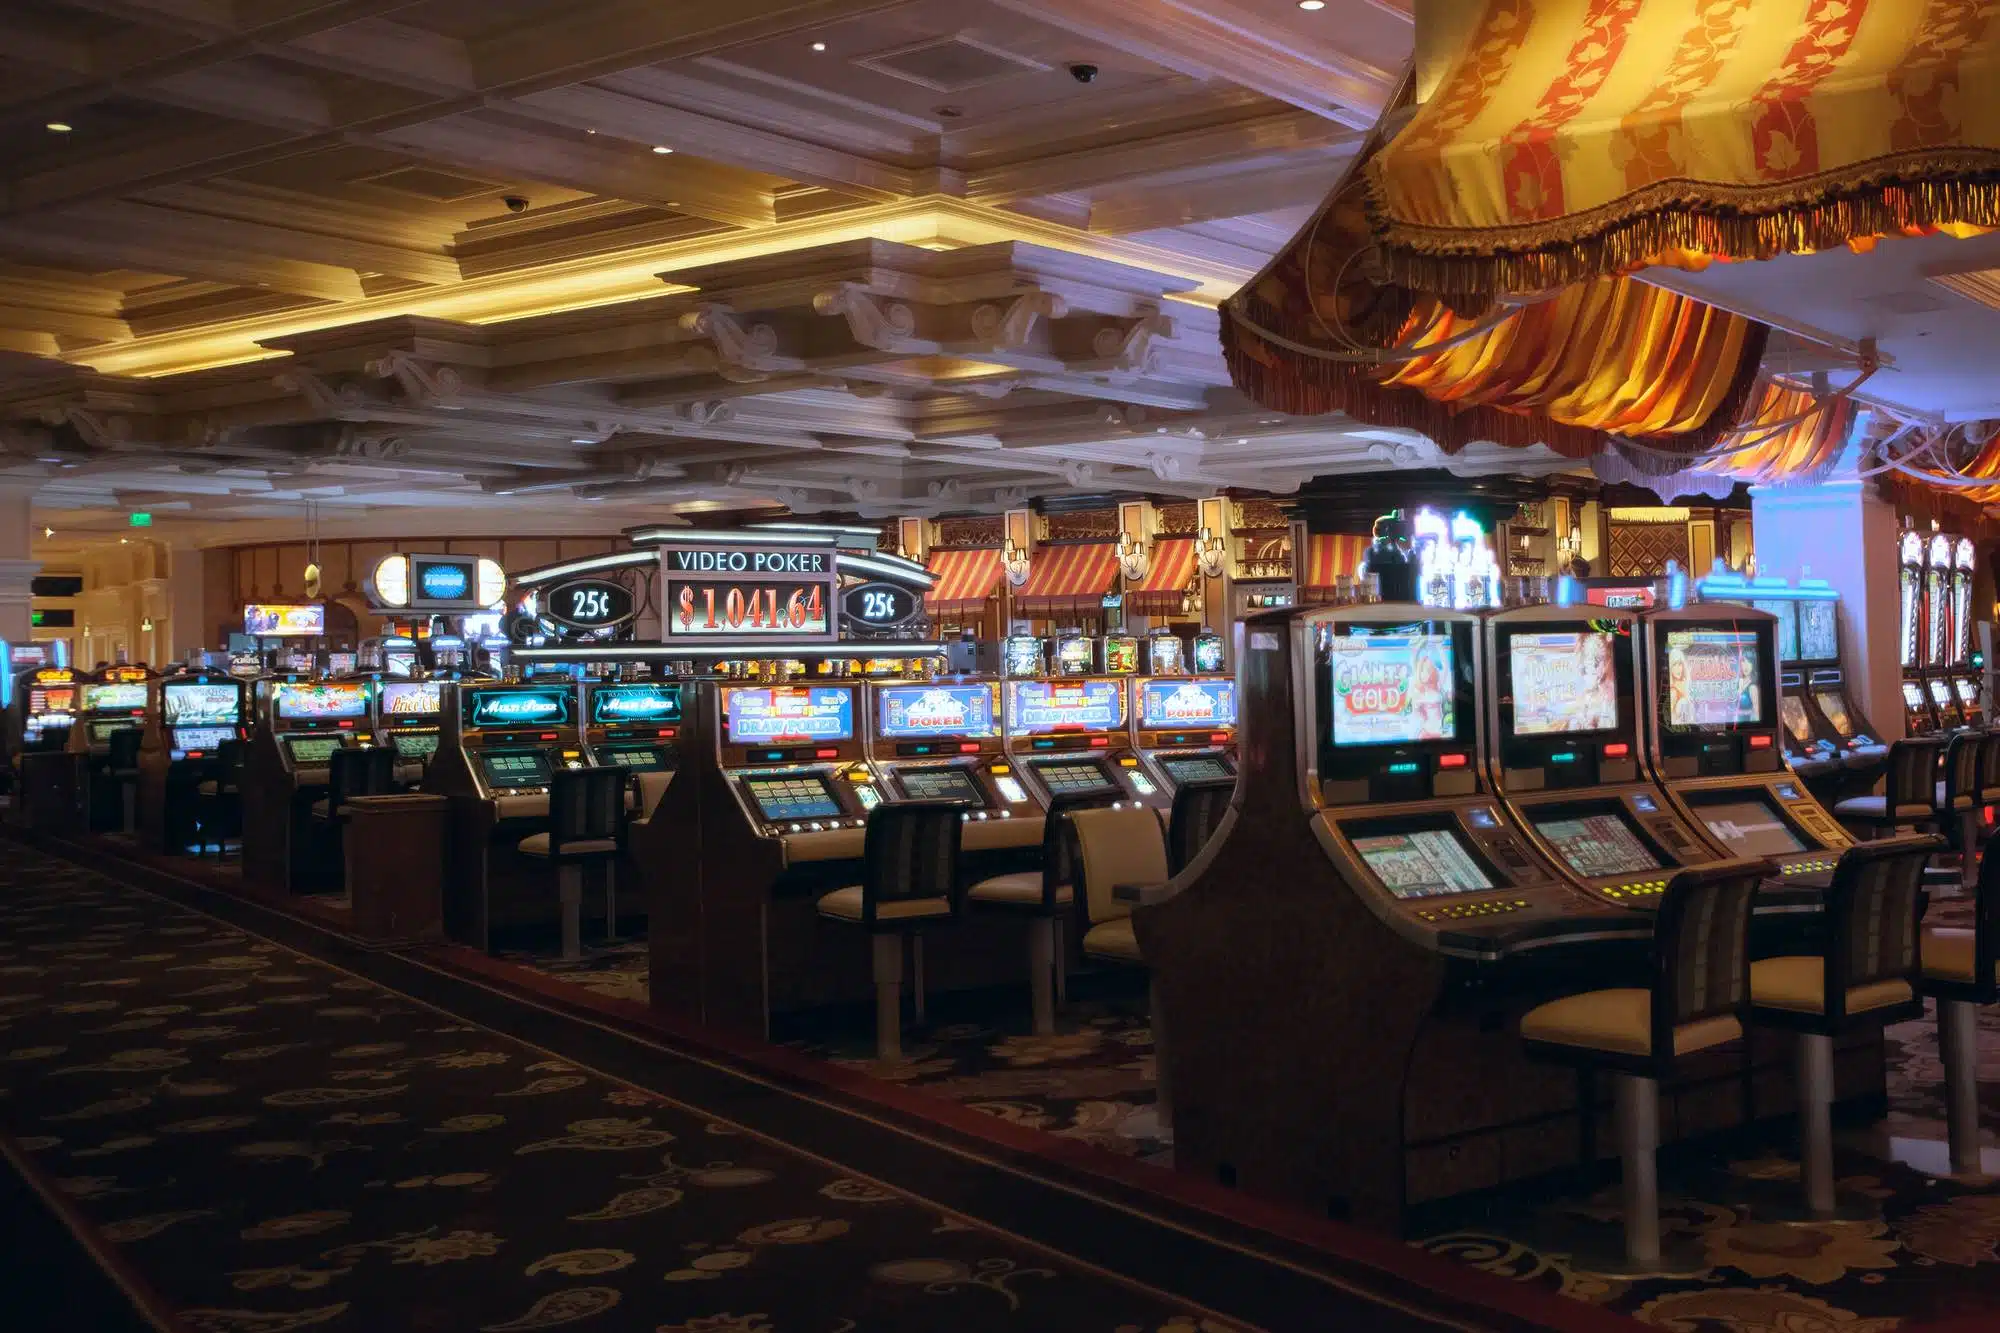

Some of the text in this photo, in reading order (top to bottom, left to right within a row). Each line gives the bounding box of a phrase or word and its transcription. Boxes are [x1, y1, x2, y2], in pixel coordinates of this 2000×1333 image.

[678, 551, 823, 573] VIDEO POKER
[573, 590, 609, 617] 25¢
[864, 592, 895, 617] 25¢
[1351, 687, 1401, 711] GOLD
[908, 714, 964, 728] POKER
[1166, 708, 1213, 719] POKER
